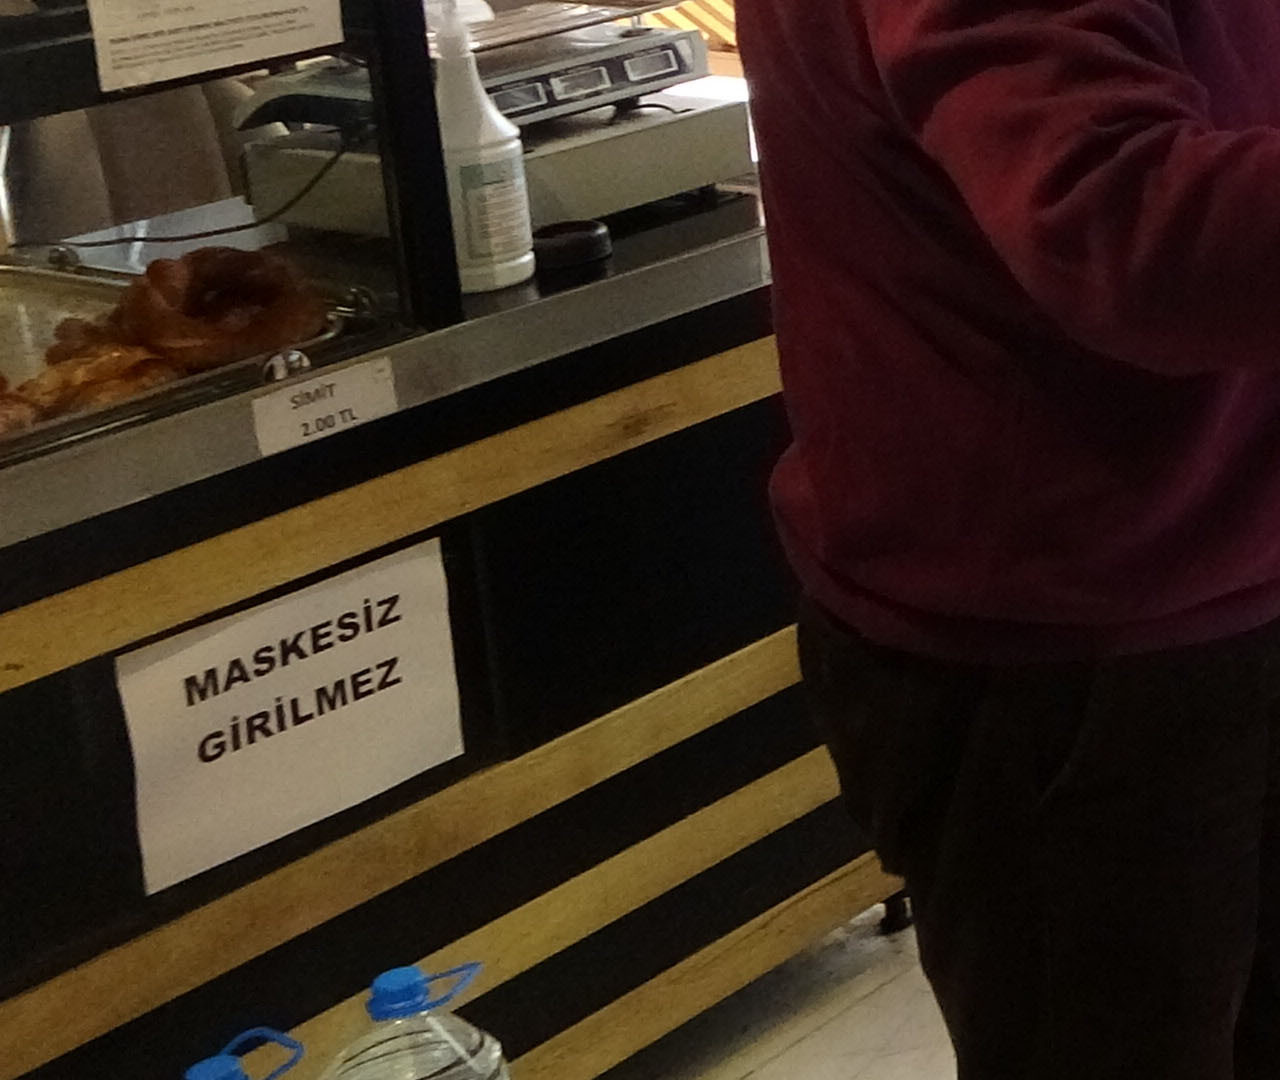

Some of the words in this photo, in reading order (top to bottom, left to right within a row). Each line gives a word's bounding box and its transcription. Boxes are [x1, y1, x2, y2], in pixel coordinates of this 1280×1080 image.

[301, 415, 336, 437] 2.00
[338, 408, 359, 423] TL
[183, 594, 403, 707] MASKESİZ
[197, 656, 403, 763] GİRİLMEZ
